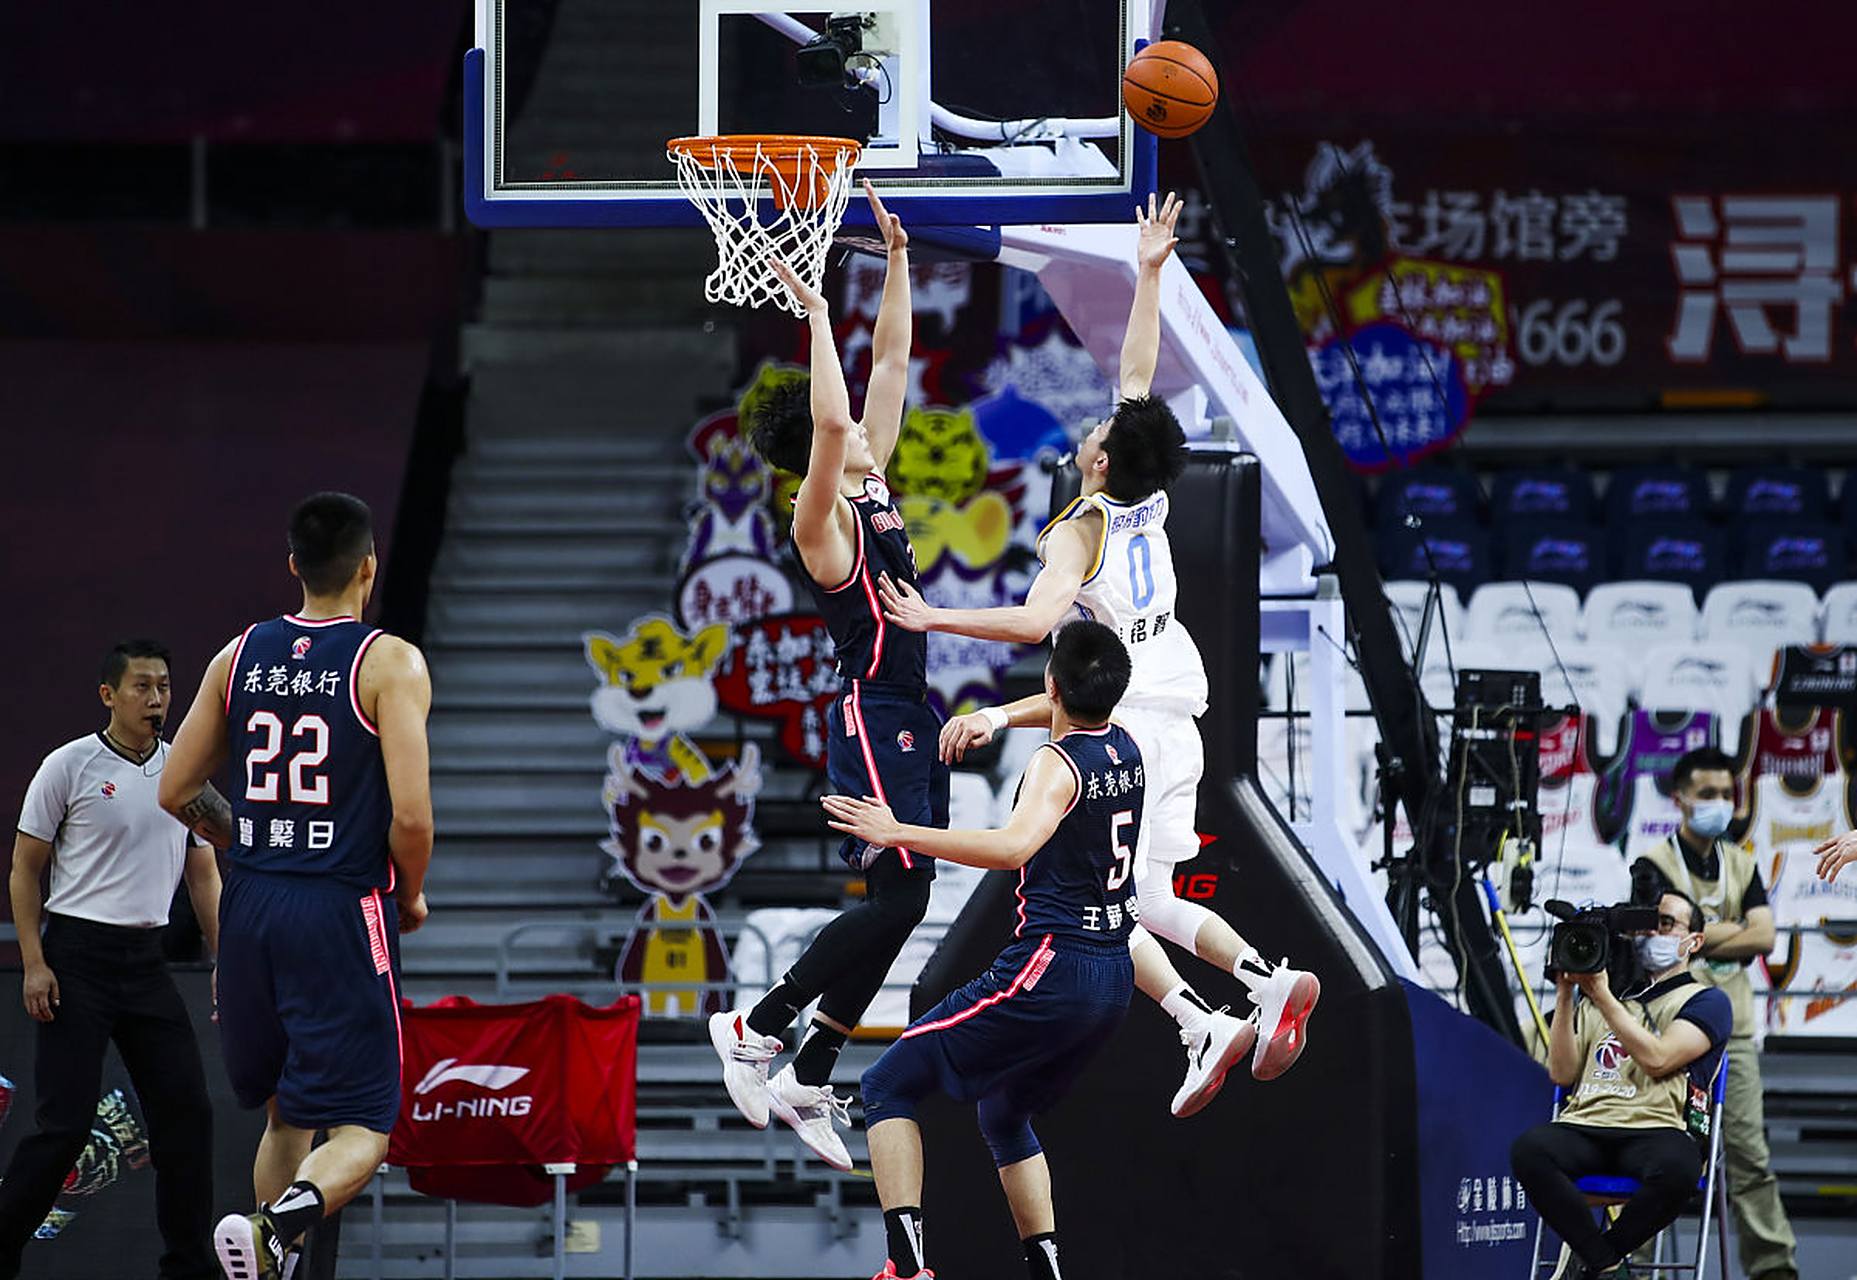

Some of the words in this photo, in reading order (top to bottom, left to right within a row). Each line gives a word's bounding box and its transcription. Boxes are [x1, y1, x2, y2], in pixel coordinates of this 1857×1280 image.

[1667, 194, 1843, 363] 浔
[1511, 298, 1627, 368] 666
[1127, 533, 1155, 610] 0
[243, 663, 342, 698] 东莞银行
[245, 710, 331, 806] 22
[1086, 764, 1144, 800] 东莞银行
[237, 817, 335, 850] 曾繁日
[1106, 809, 1135, 892] 5
[411, 1095, 533, 1122] LI-NING
